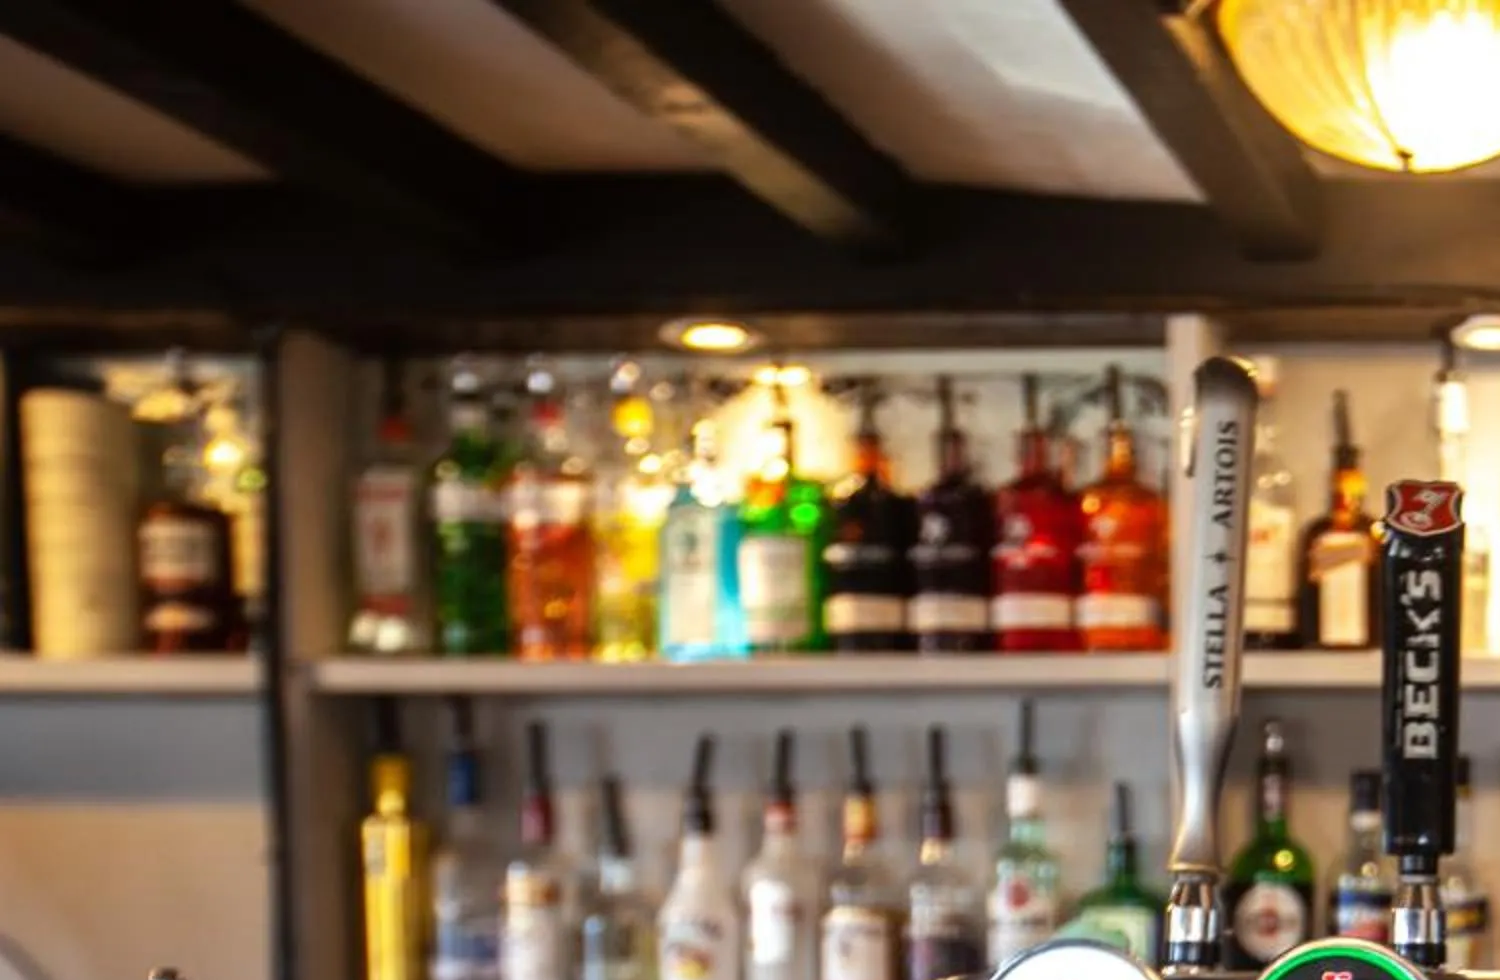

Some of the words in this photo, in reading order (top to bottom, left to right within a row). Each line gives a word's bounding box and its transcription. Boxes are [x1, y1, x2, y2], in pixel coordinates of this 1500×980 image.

[1212, 421, 1239, 528] ARTOIS
[1204, 583, 1229, 689] STELLA
[1403, 568, 1442, 760] BECK'S
